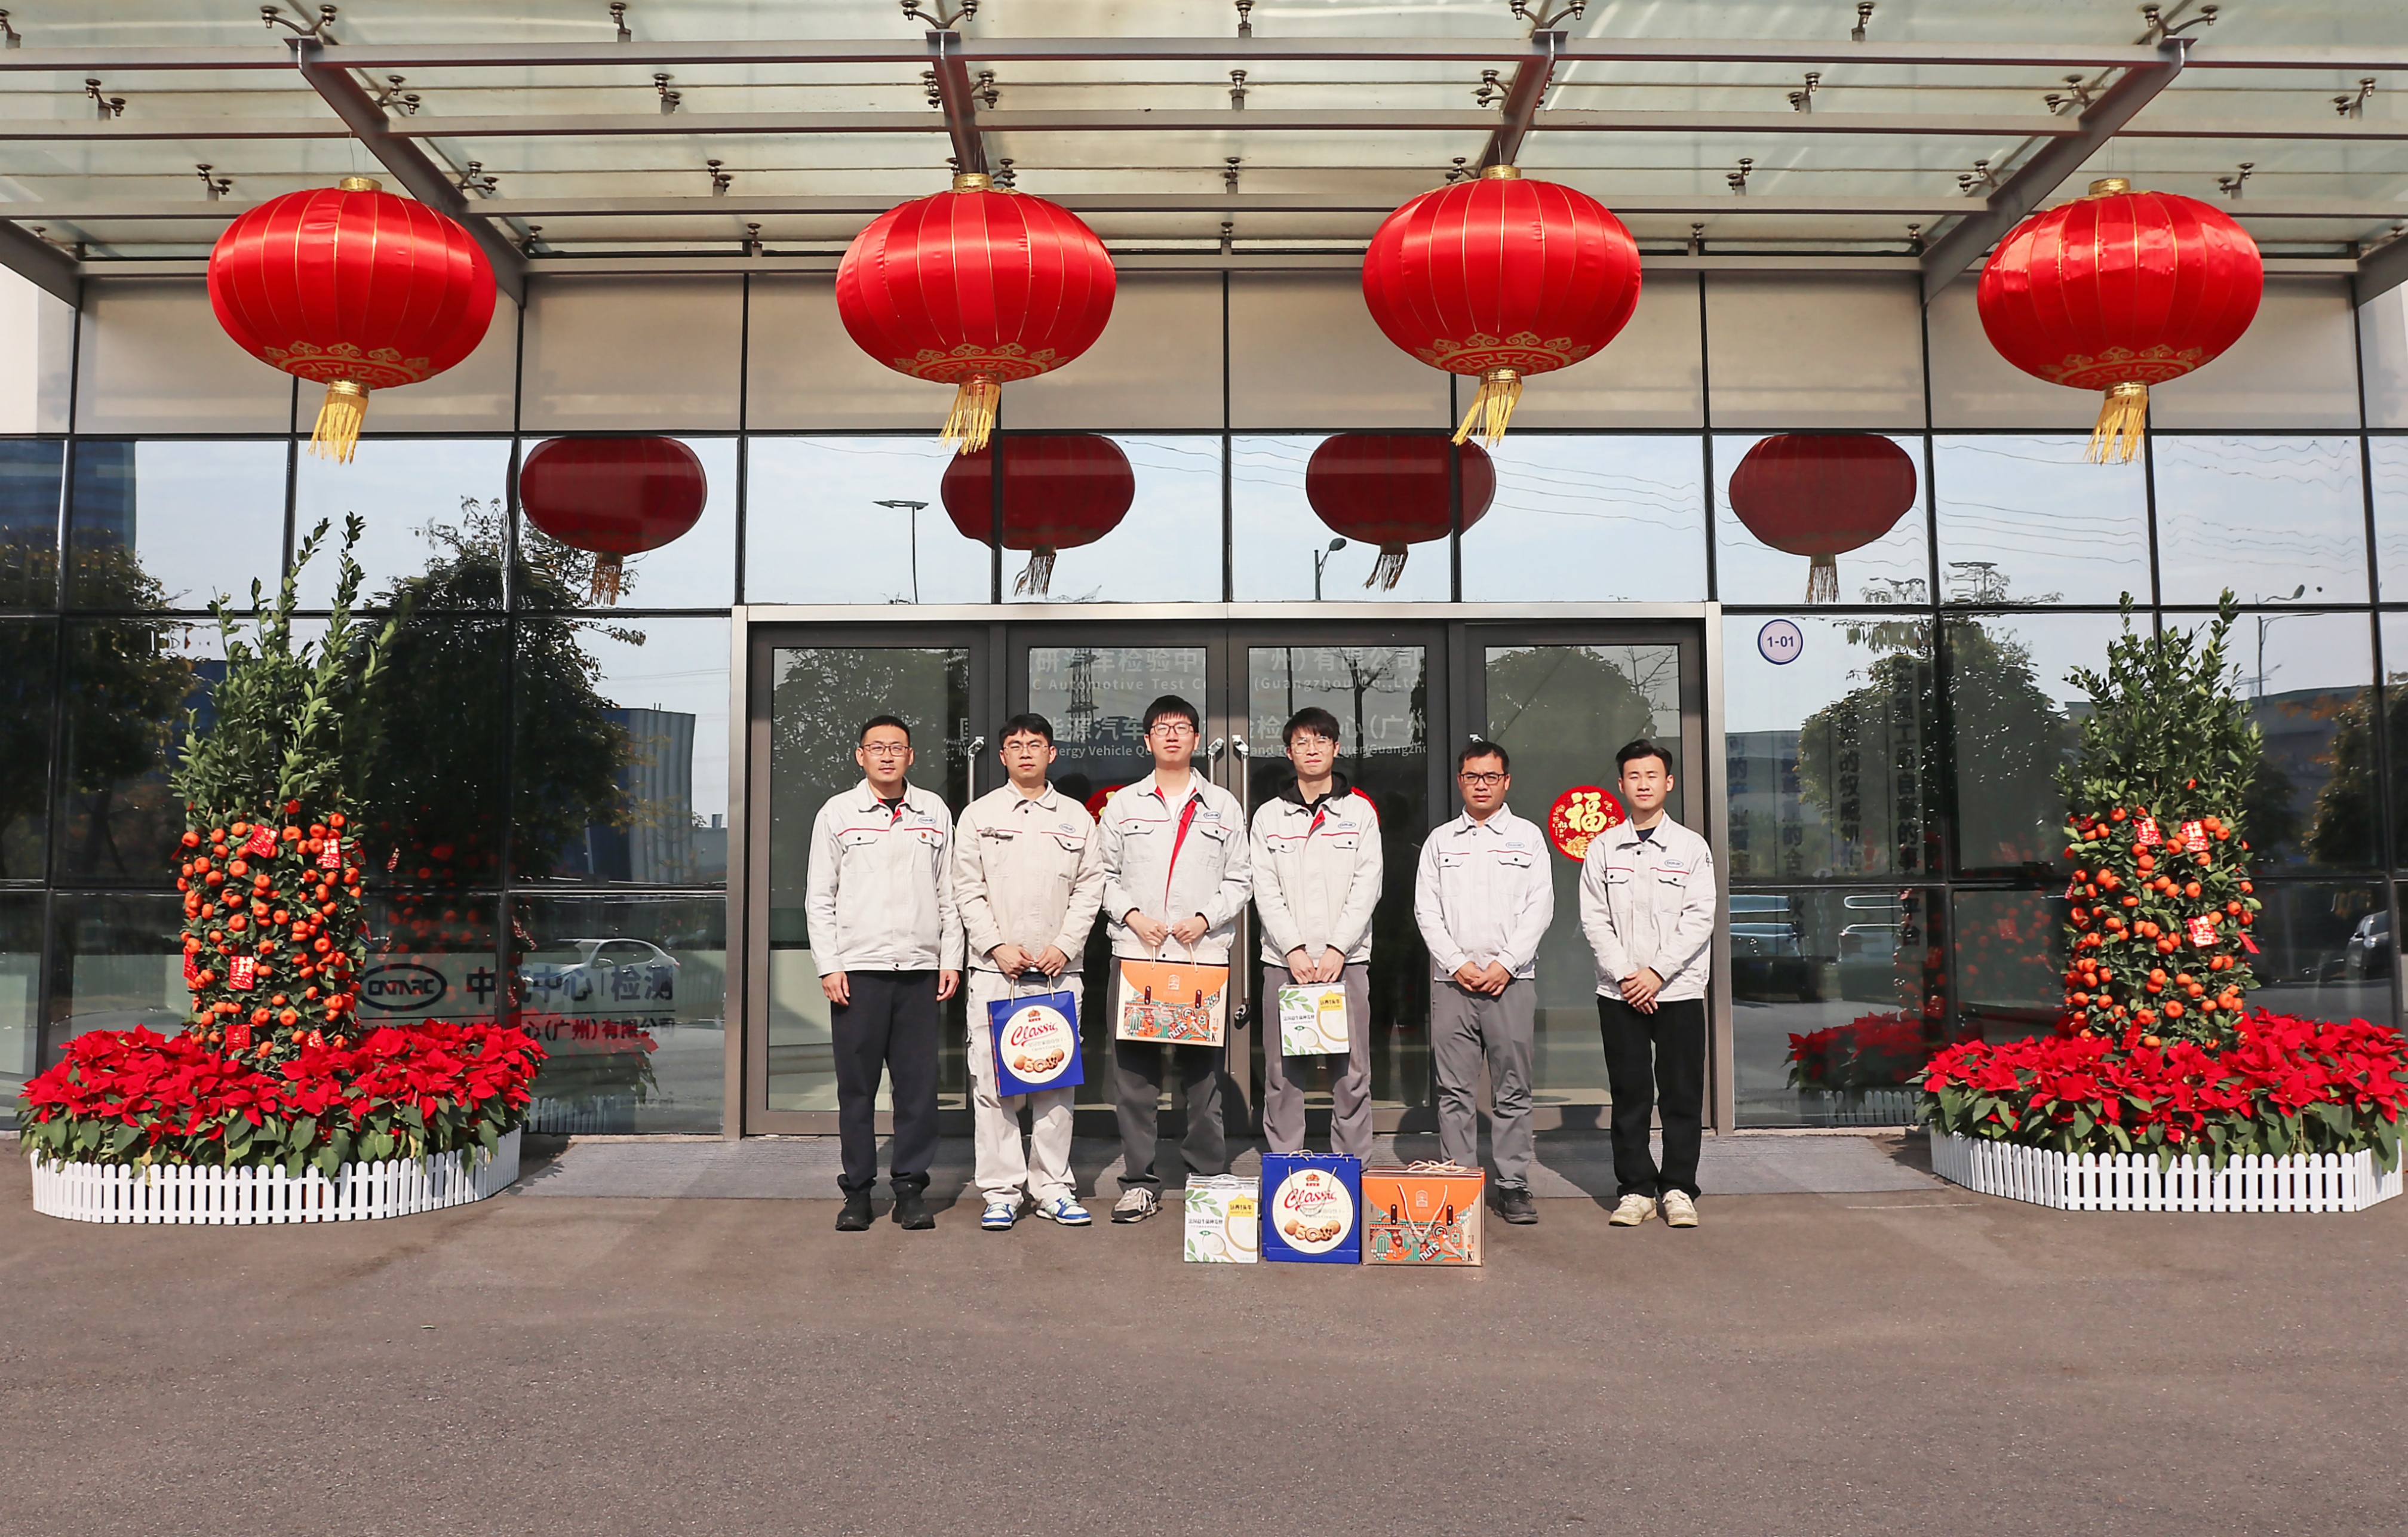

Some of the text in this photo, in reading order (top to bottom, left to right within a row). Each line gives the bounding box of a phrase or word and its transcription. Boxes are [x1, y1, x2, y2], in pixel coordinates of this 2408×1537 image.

[1767, 635, 1794, 647] 1-01
[1049, 678, 1144, 690] Automotive
[1152, 678, 1184, 690] Test
[1057, 748, 1086, 759] ergy
[1088, 745, 1132, 757] Vehicle
[1565, 792, 1608, 832] 福
[611, 965, 674, 1002] 检测
[1010, 1022, 1058, 1046] Classic
[1284, 1188, 1337, 1209] Classic
